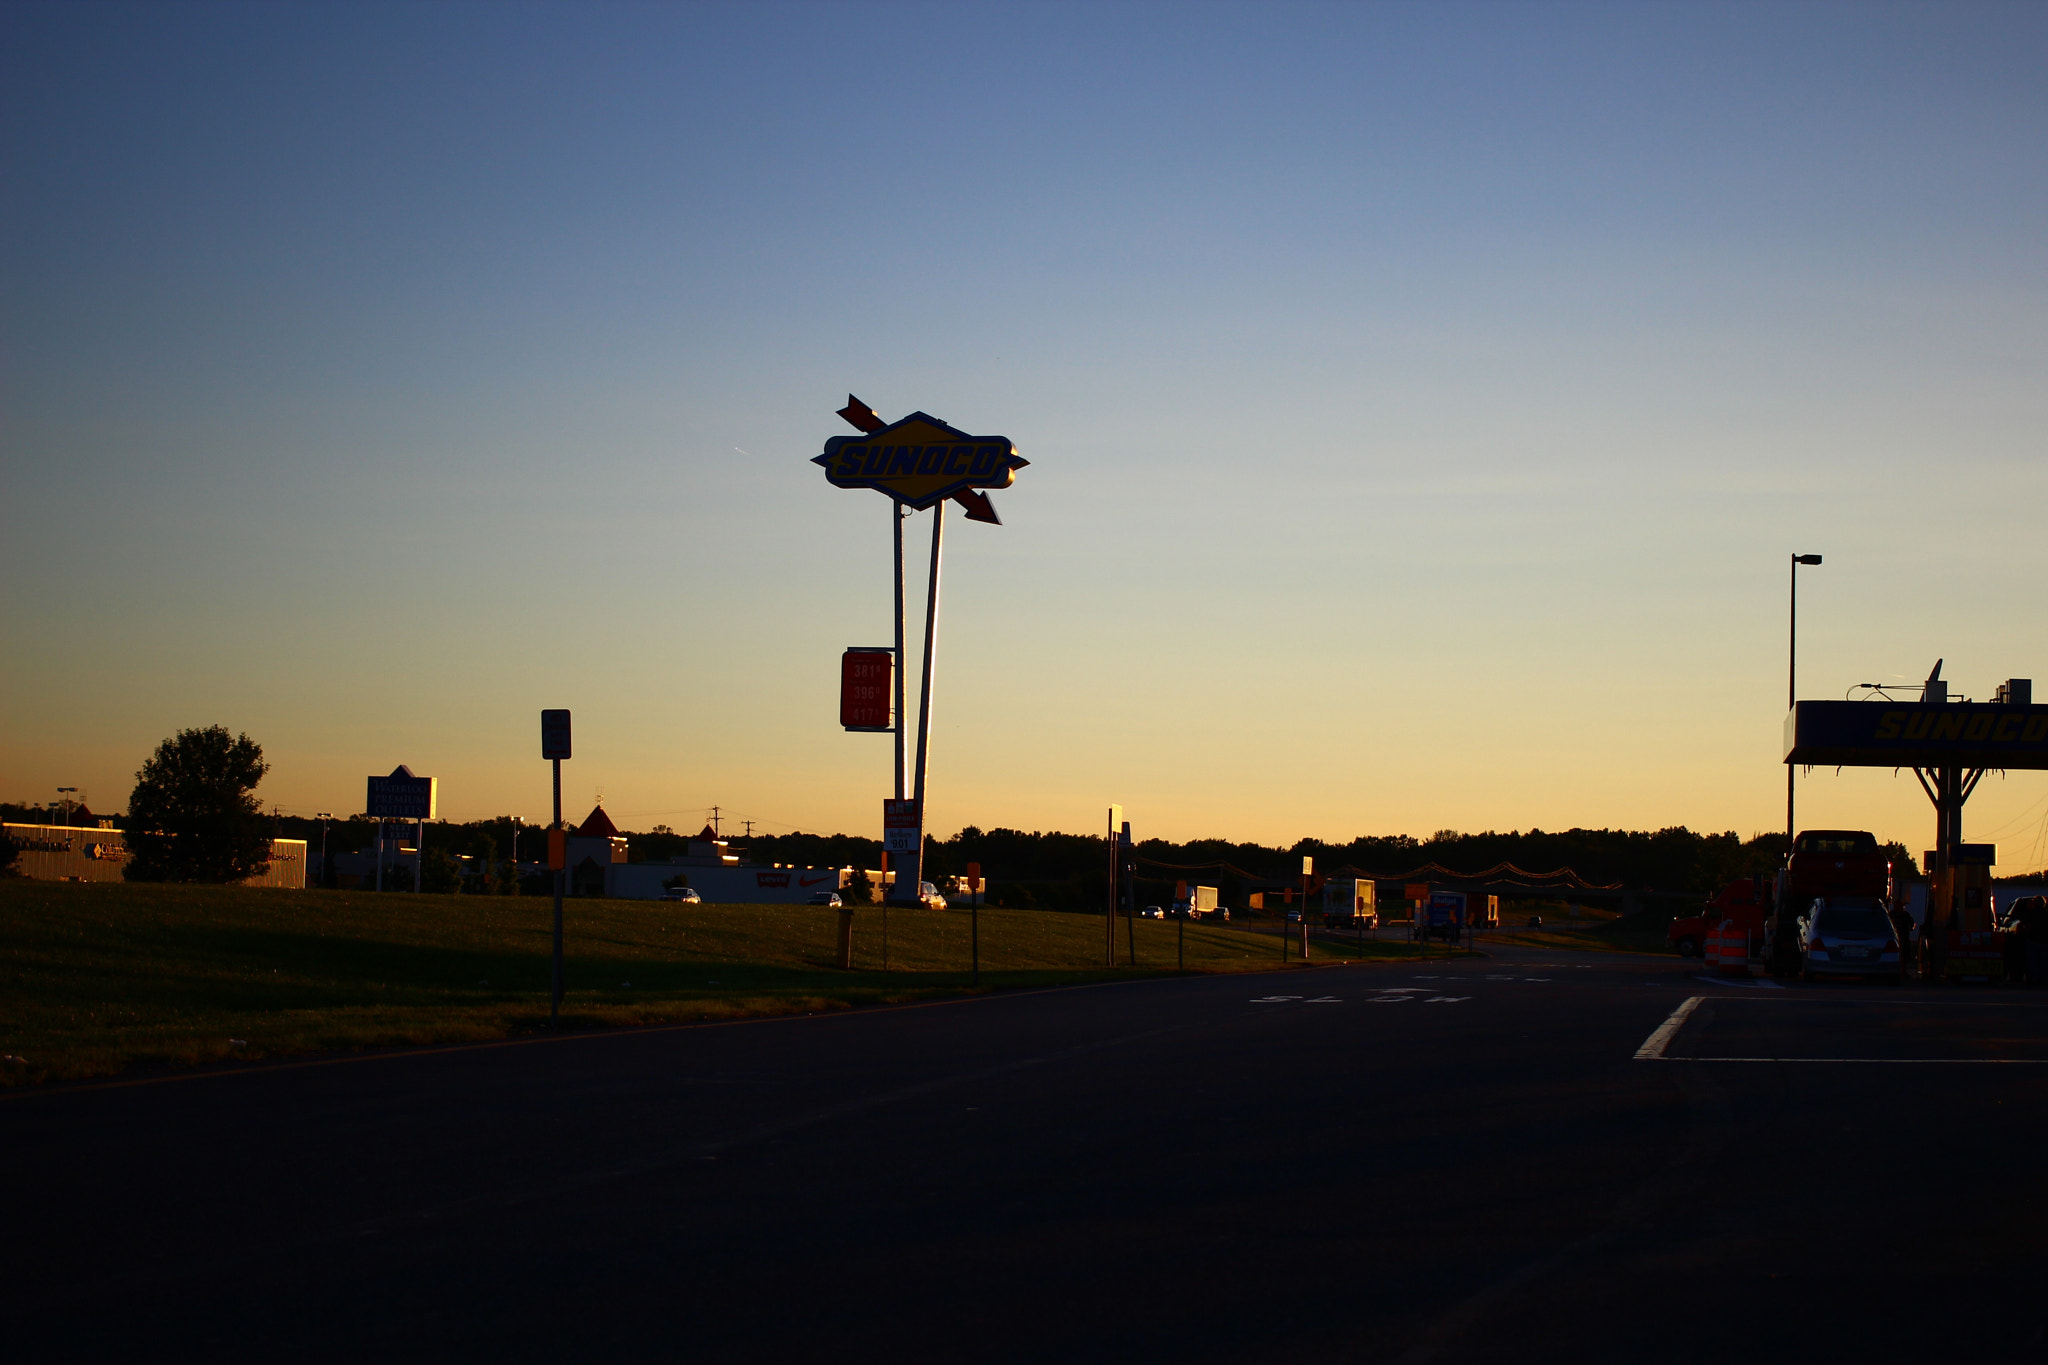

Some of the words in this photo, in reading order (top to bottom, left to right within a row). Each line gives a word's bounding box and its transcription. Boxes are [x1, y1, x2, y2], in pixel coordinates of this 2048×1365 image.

[835, 445, 1001, 476] SUNOCO
[1873, 711, 2048, 742] SUNOCO
[375, 780, 428, 793] WATERLOO
[375, 794, 426, 804] PREMIUM
[375, 804, 424, 815] OUTLETS
